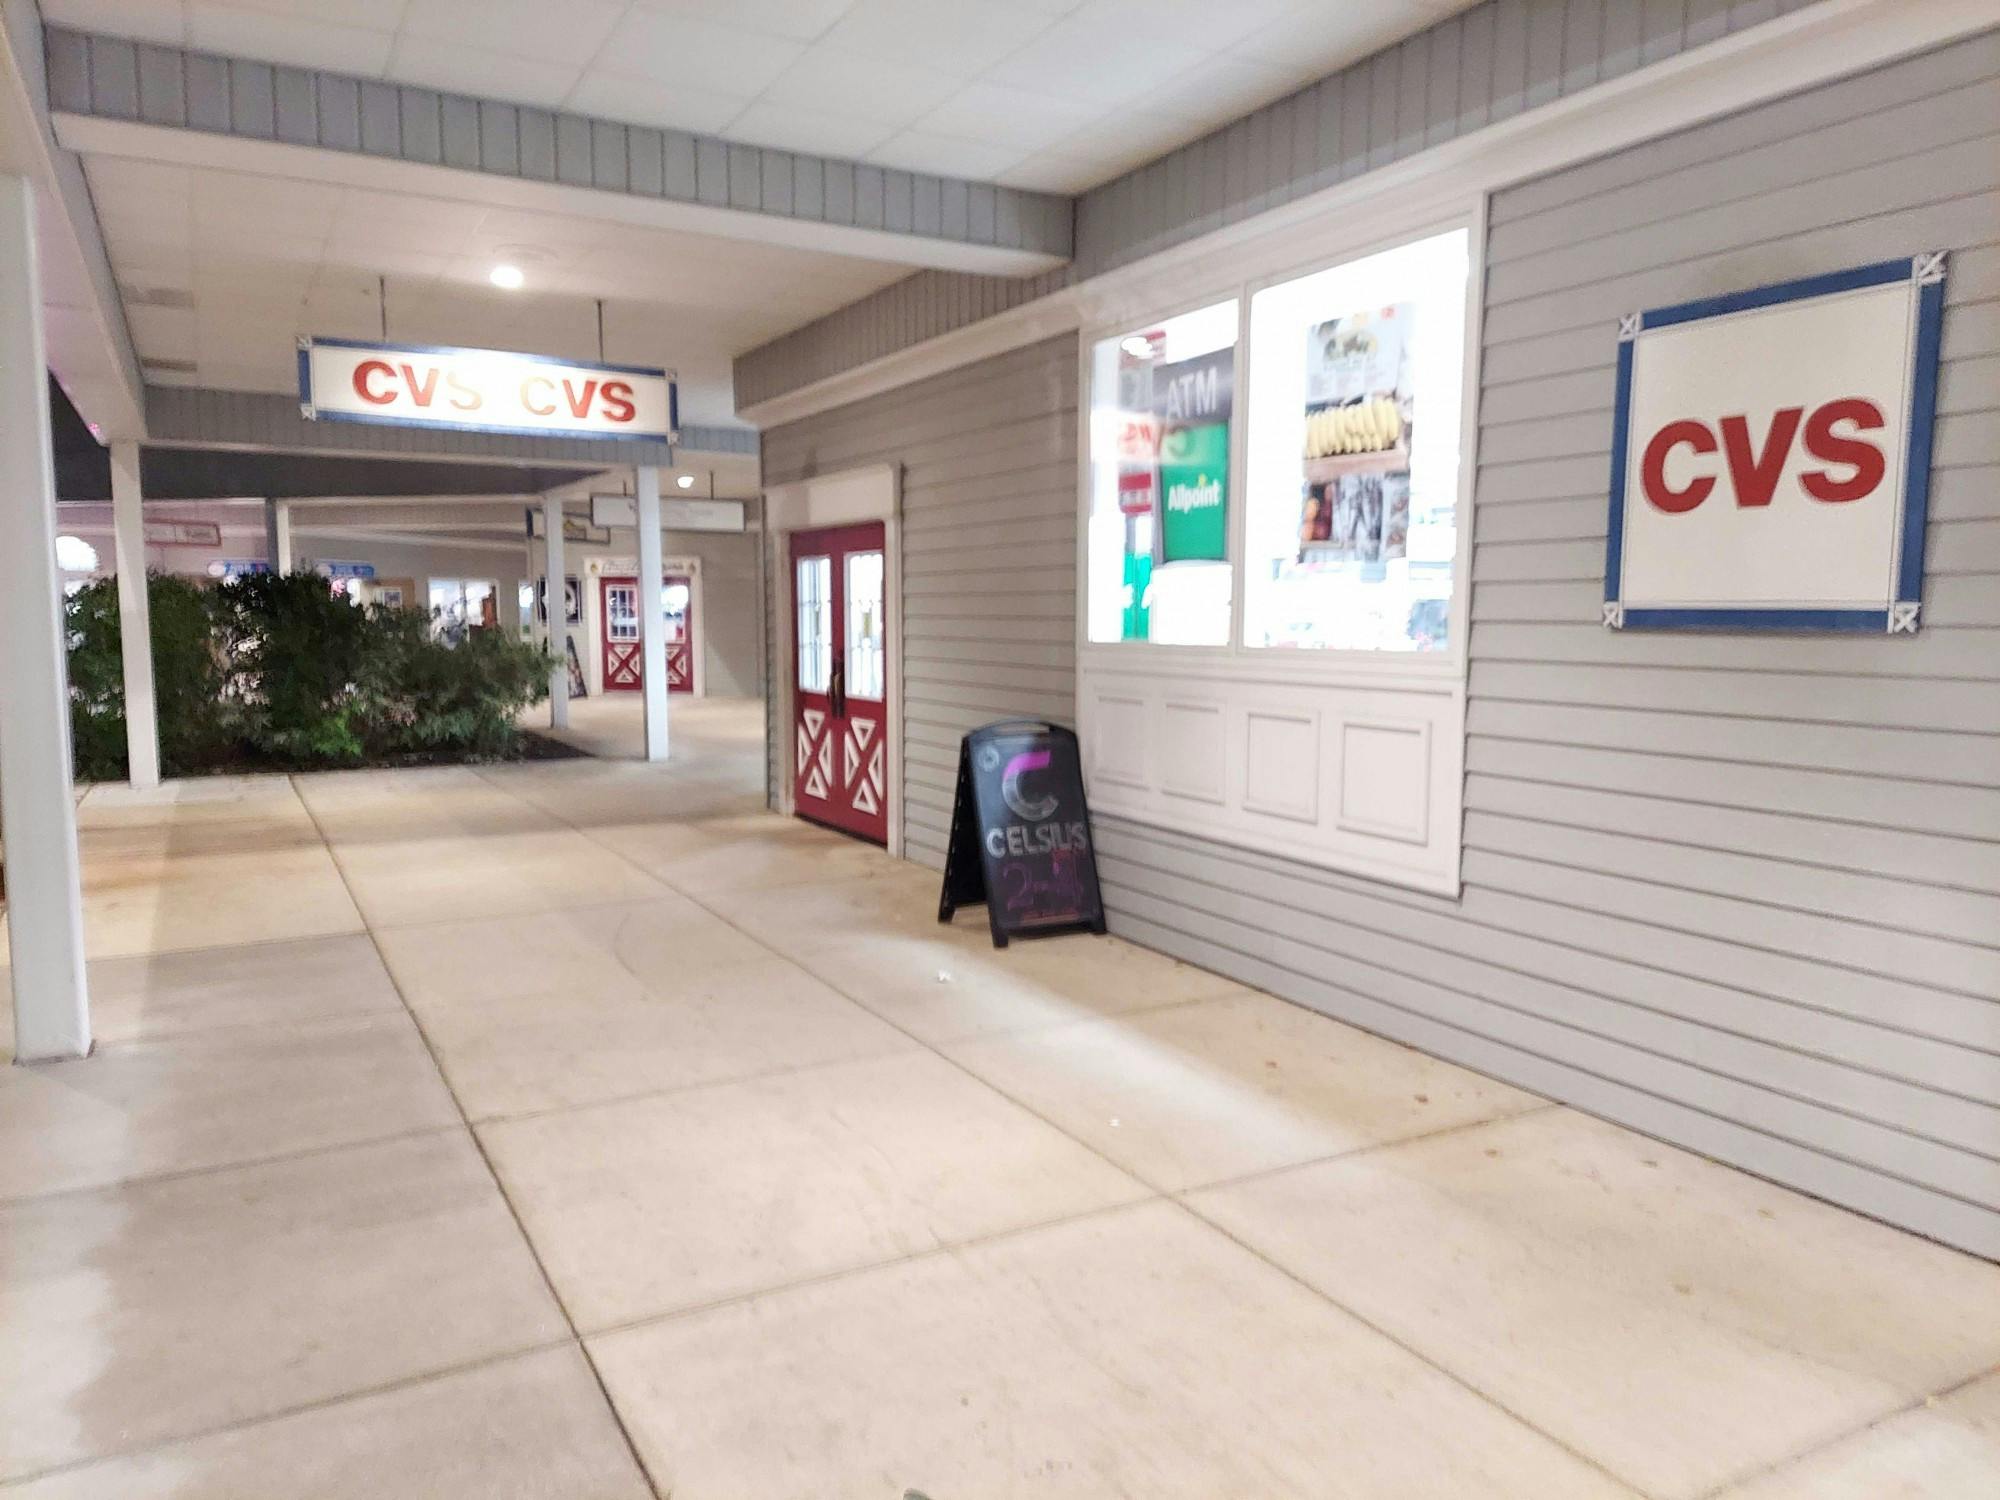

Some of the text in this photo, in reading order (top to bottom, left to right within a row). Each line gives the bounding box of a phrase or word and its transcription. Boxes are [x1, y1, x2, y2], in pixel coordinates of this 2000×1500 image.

[352, 360, 637, 423] CVS CVS
[1166, 366, 1218, 420] ATM
[1641, 397, 1887, 515] CVS
[1167, 475, 1221, 516] Allpoint
[986, 821, 1088, 859] CELSIUS
